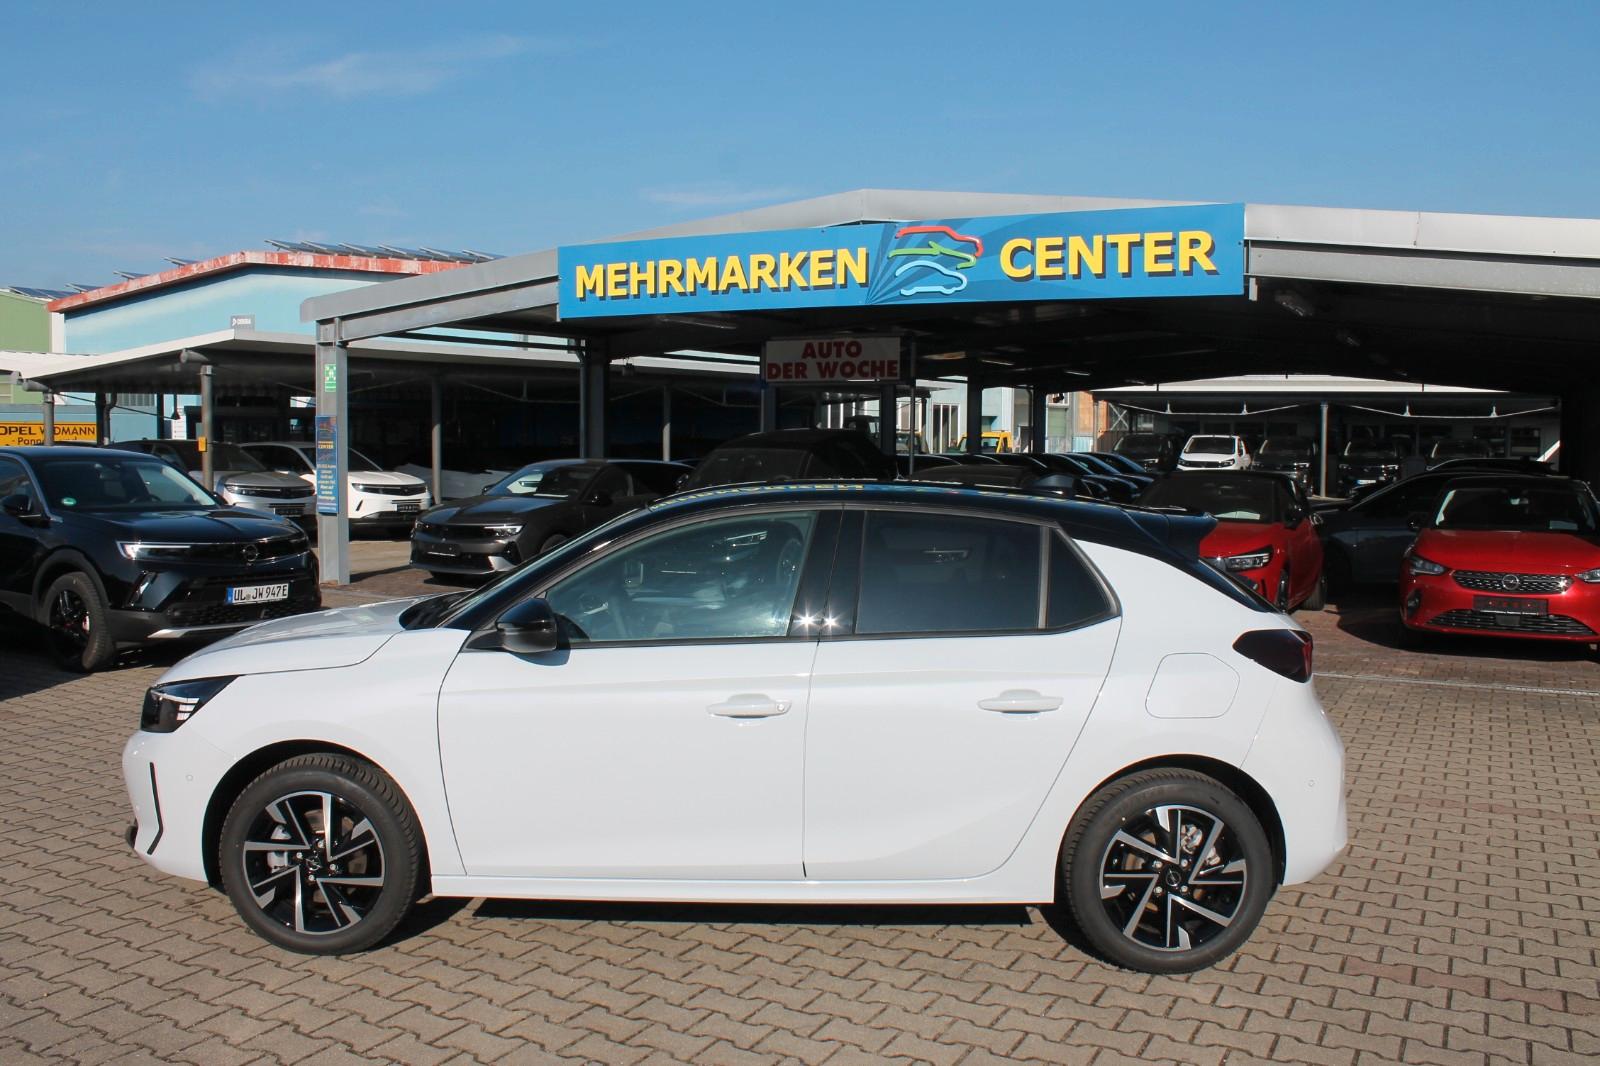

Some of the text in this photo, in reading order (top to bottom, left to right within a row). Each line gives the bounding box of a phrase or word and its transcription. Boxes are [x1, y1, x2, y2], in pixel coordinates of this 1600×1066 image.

[576, 230, 1219, 300] MEHRMARKEN CENTER
[801, 341, 862, 359] AUTO
[767, 360, 898, 379] DER WOCHE
[234, 585, 287, 600] UL JW 947E
